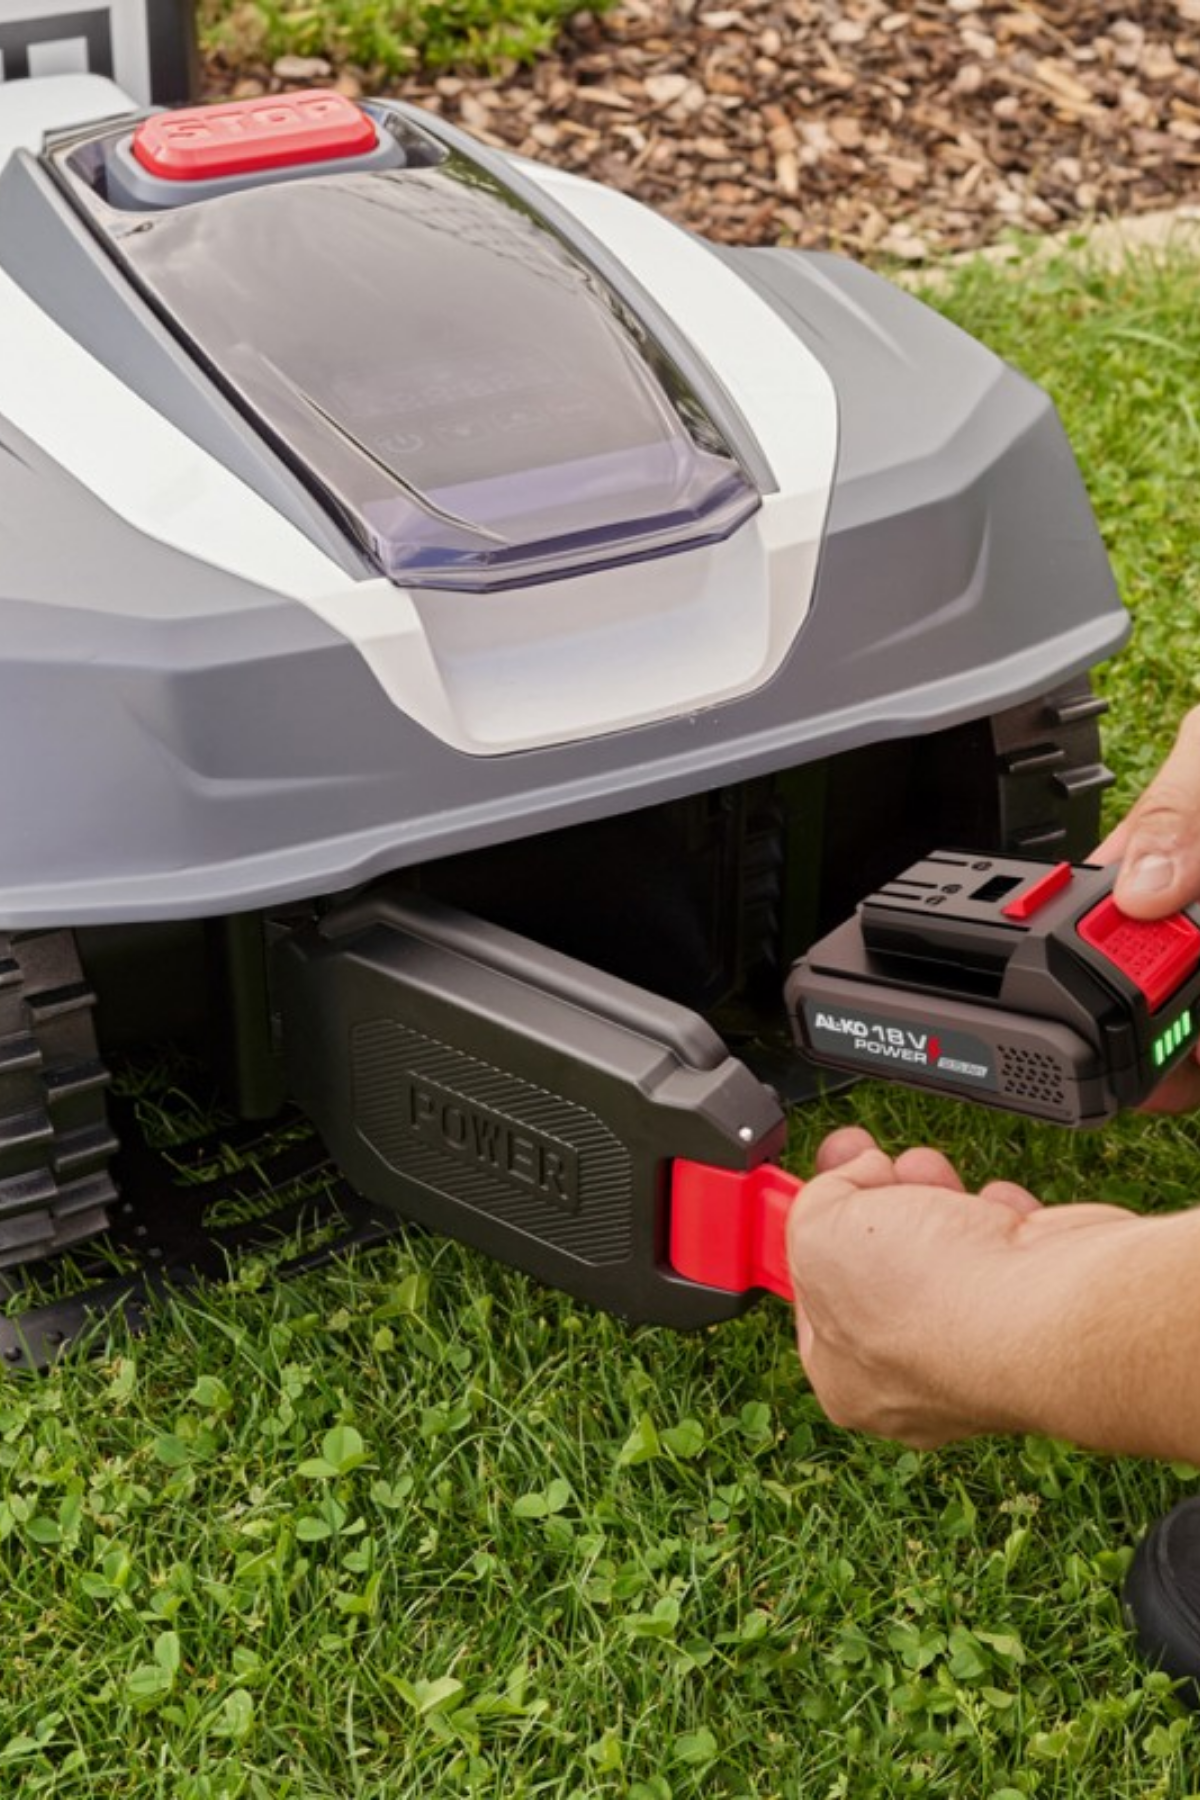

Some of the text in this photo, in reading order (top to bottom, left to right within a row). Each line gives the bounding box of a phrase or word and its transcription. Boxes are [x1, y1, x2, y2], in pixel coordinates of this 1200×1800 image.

[160, 97, 343, 141] STOP
[854, 1038, 927, 1065] POWER
[409, 1083, 569, 1201] POWER
